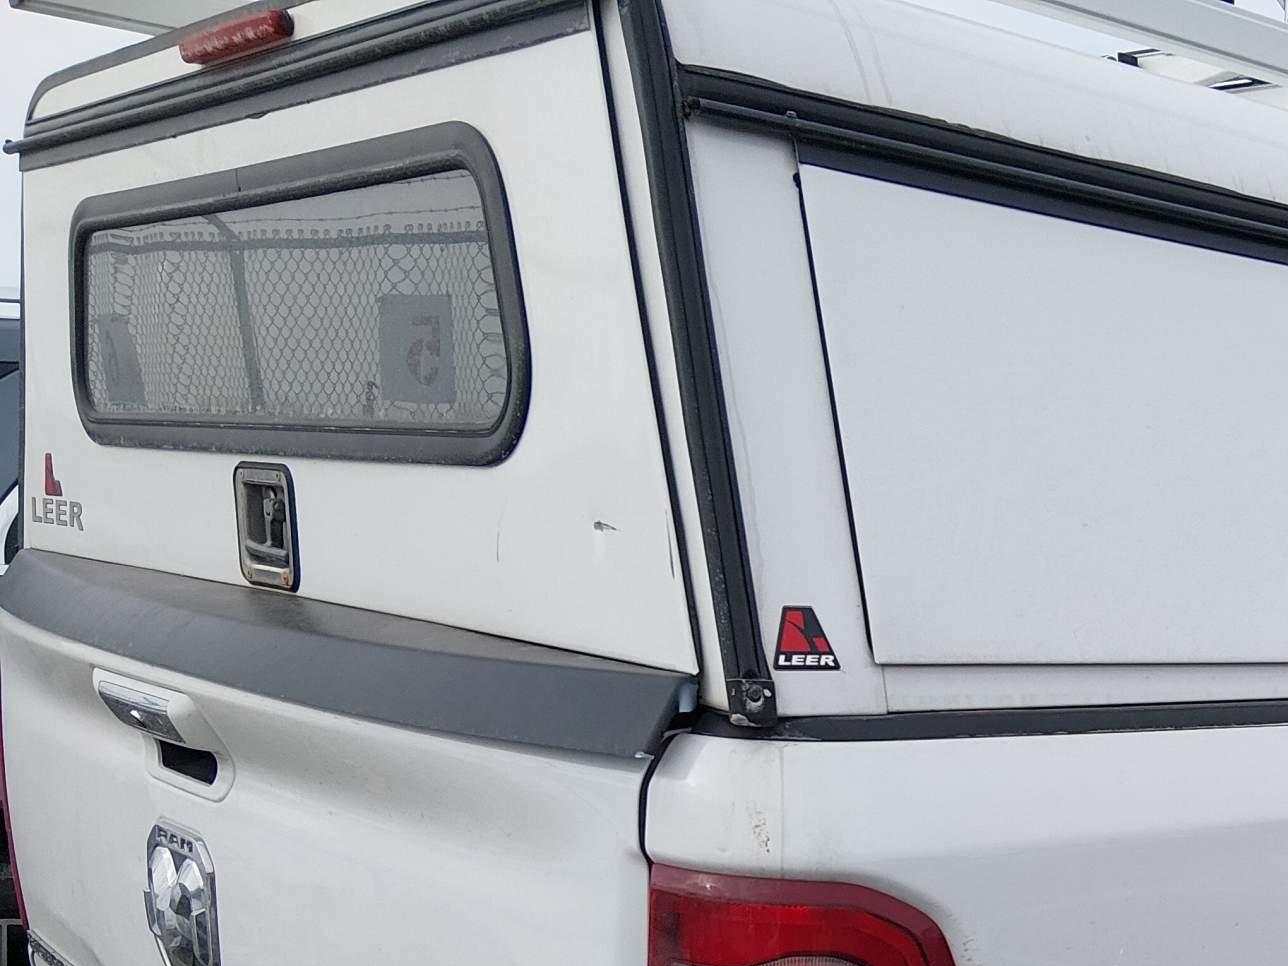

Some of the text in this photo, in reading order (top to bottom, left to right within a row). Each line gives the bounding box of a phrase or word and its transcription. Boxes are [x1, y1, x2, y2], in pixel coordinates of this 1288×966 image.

[31, 496, 85, 532] LEER
[778, 654, 836, 667] LEER
[155, 826, 194, 853] RAM
